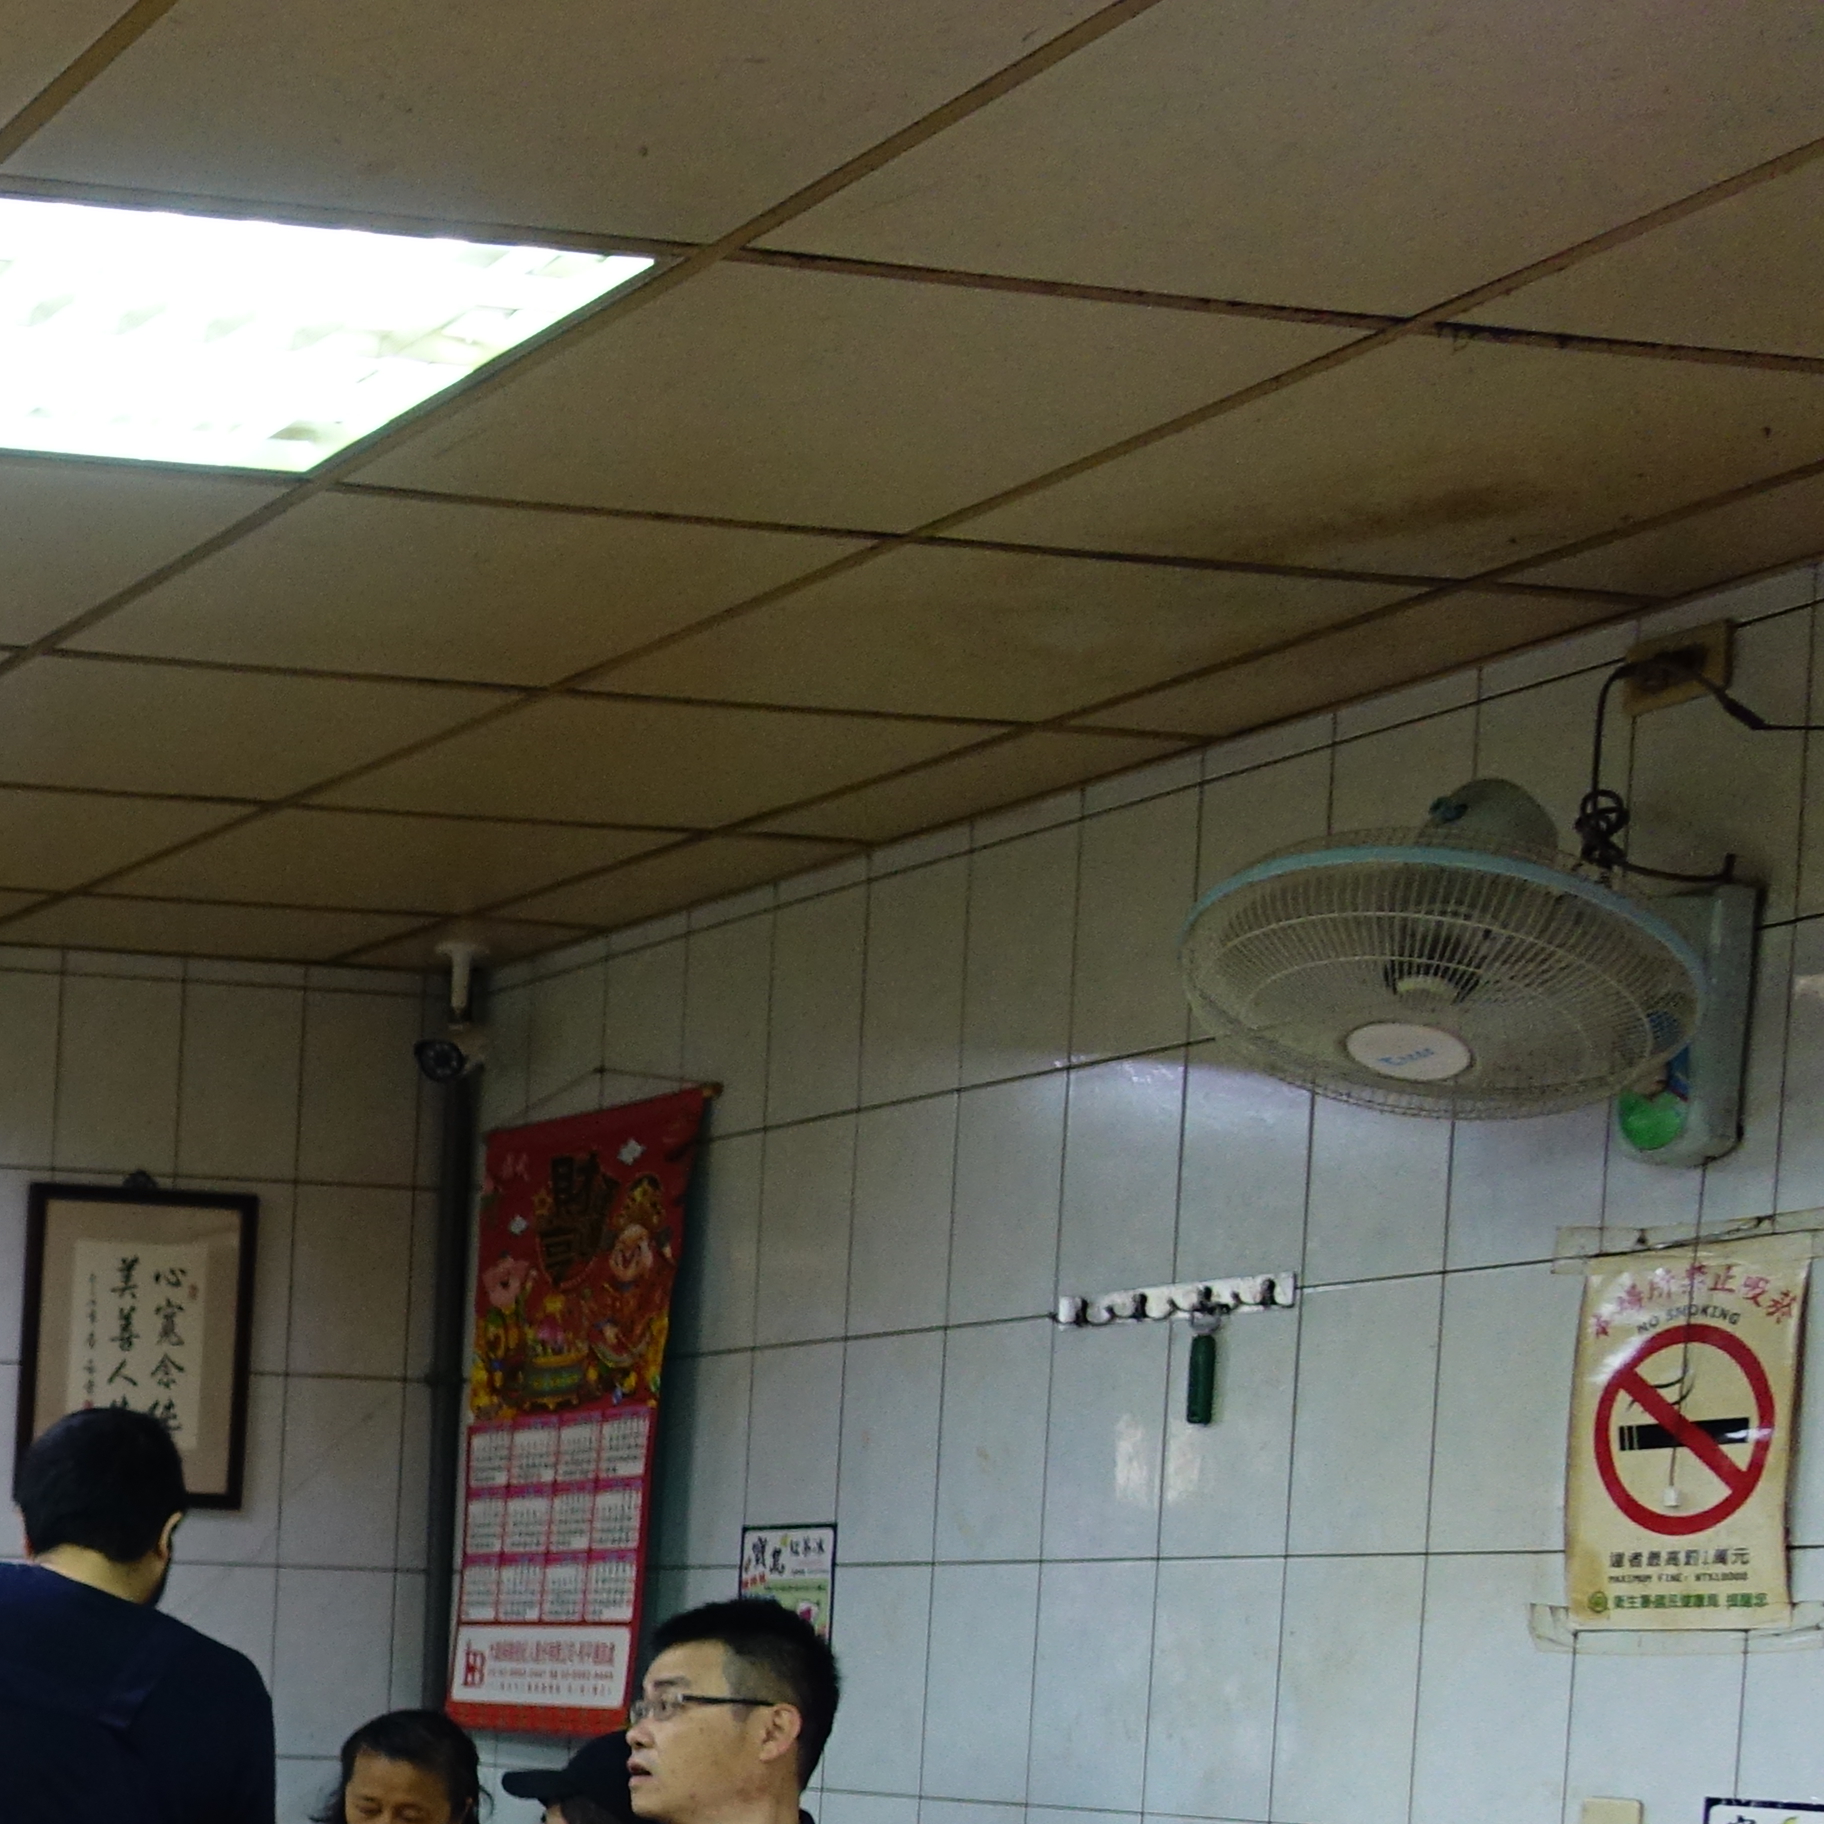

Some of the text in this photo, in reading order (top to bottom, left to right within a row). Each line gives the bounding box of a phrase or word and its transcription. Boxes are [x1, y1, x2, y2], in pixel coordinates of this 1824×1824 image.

[106, 1256, 141, 1410] 美善人
[1637, 1303, 1742, 1333] NO SMOKING
